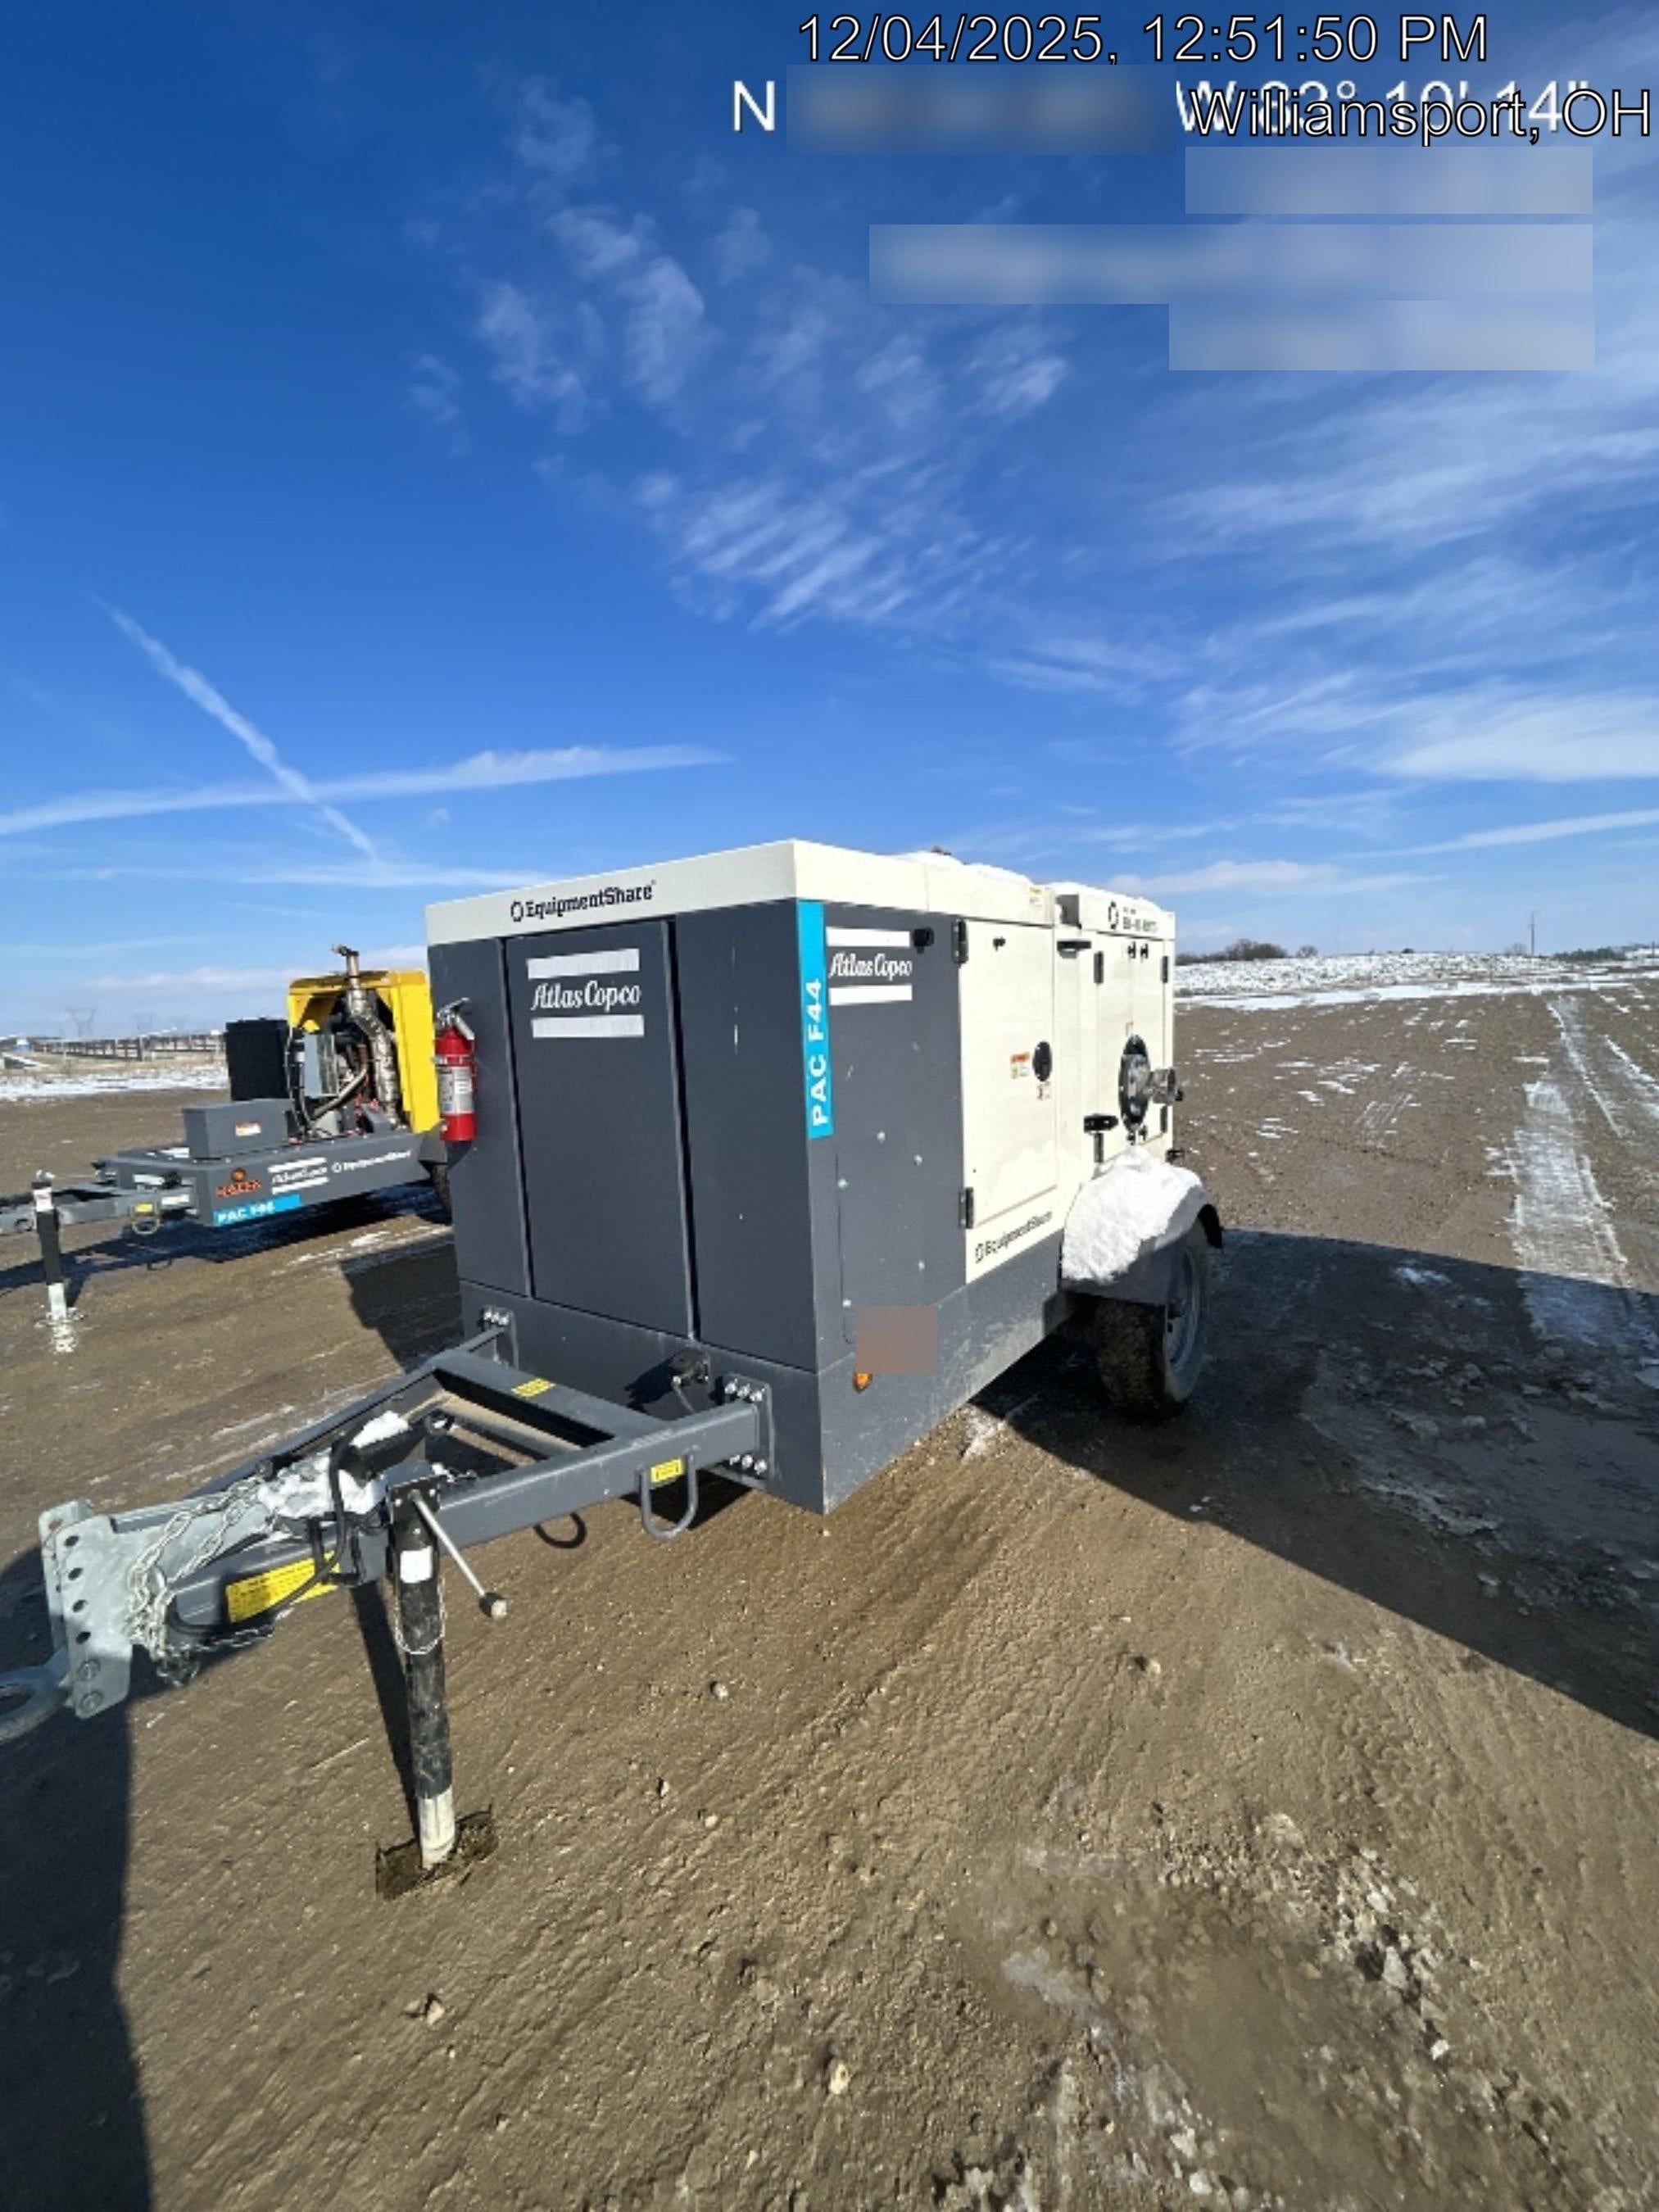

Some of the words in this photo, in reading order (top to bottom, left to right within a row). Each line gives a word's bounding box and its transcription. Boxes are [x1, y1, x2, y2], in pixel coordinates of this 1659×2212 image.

[827, 952, 873, 978] Atlas
[530, 982, 583, 1011] Atlas
[584, 979, 642, 1013] Copco
[805, 977, 824, 1042] F44
[809, 1053, 829, 1126] PAC
